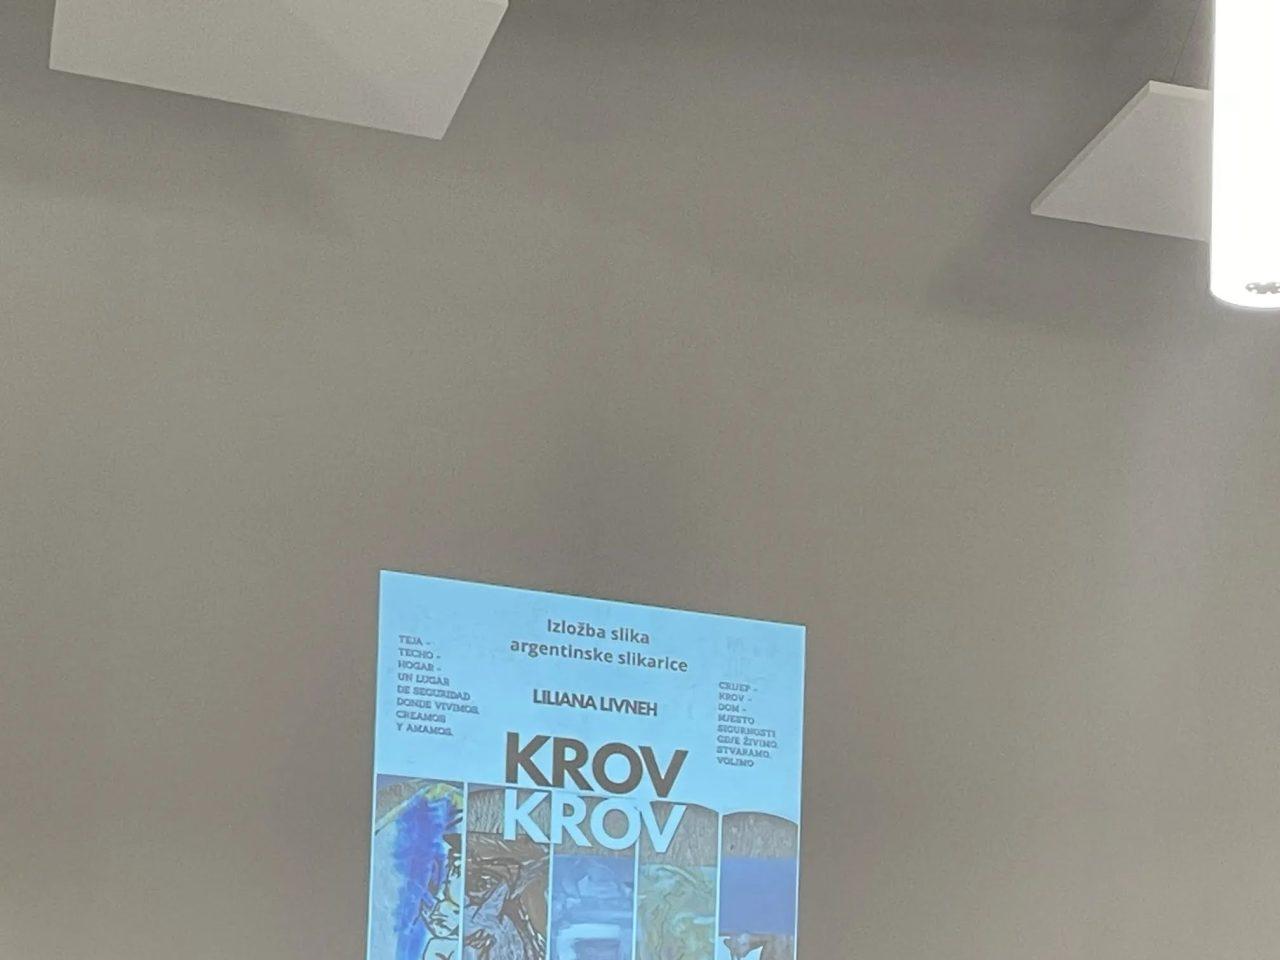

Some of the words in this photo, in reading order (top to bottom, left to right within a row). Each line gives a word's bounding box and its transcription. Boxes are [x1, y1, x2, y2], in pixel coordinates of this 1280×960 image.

[546, 618, 607, 640] Izložba
[610, 627, 651, 645] slika
[398, 634, 424, 646] TEJA
[398, 647, 435, 660] TECHO
[509, 639, 614, 664] argentinske
[617, 653, 689, 673] slikarice
[398, 660, 435, 672] HOGAR
[397, 673, 413, 683] UN
[415, 674, 451, 687] LUGAR
[396, 685, 411, 694] DE
[412, 686, 472, 701] SEGURIDAD
[718, 692, 745, 702] KROV
[396, 697, 433, 709] DONDE
[532, 688, 598, 711] LILIANA
[600, 696, 658, 717] LIVNEH
[718, 703, 741, 713] DOM
[504, 731, 689, 798] KROV
[503, 788, 688, 854] KROV
